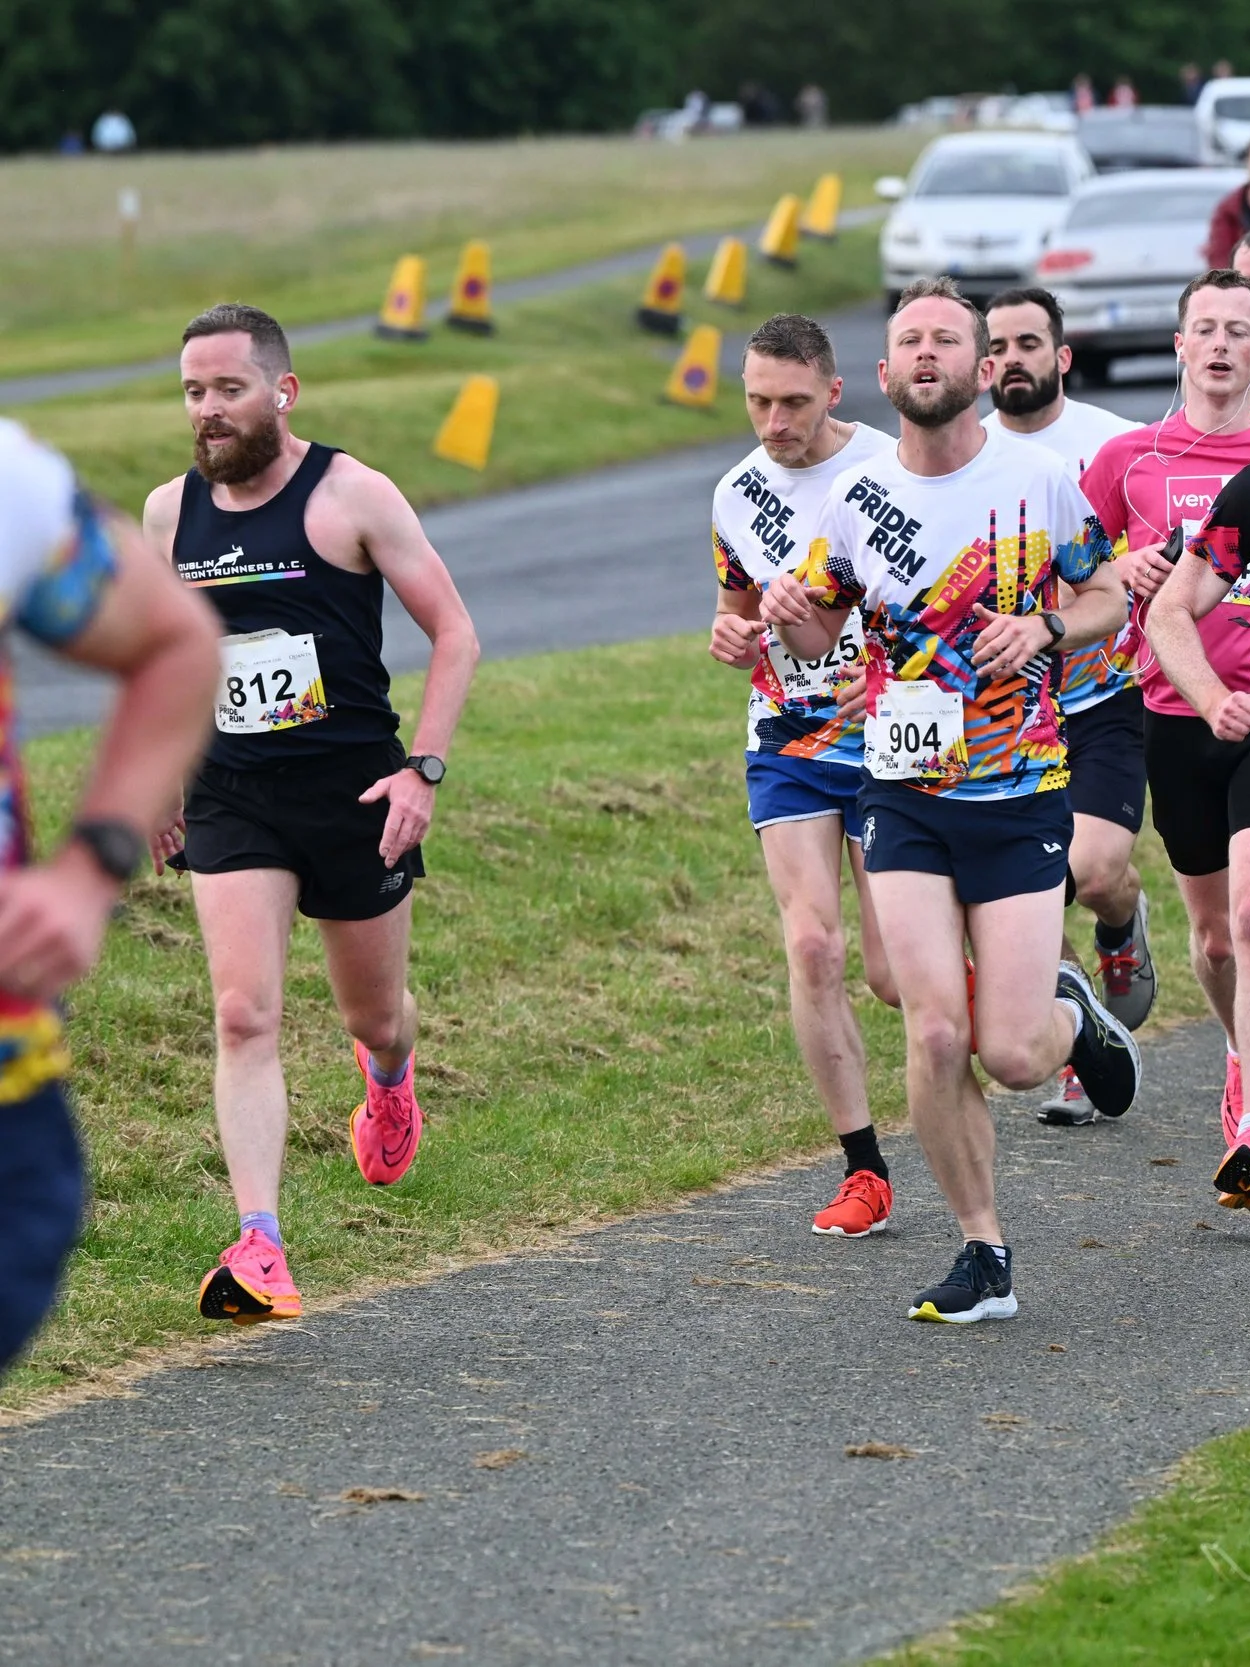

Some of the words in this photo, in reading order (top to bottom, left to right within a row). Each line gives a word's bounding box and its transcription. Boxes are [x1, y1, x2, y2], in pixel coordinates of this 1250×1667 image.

[859, 476, 890, 498] DUBLIN
[731, 471, 796, 530] PRIDE
[1172, 493, 1217, 511] very
[844, 482, 923, 545] PRIDE
[750, 511, 796, 560] RUN
[762, 549, 781, 567] 2024
[866, 525, 927, 578] RUN
[178, 560, 215, 571] DUBLIN
[180, 562, 274, 580] FRONTRUNNERS
[278, 560, 305, 569] A.C.
[939, 537, 990, 601] PRIDE
[887, 566, 911, 586] 2024
[227, 668, 296, 708] 812
[785, 673, 806, 684] PRIDE
[796, 679, 811, 688] RUN
[219, 706, 238, 716] PRIDE
[229, 715, 245, 723] RUN
[889, 722, 942, 753] 904
[886, 761, 899, 769] RUN
